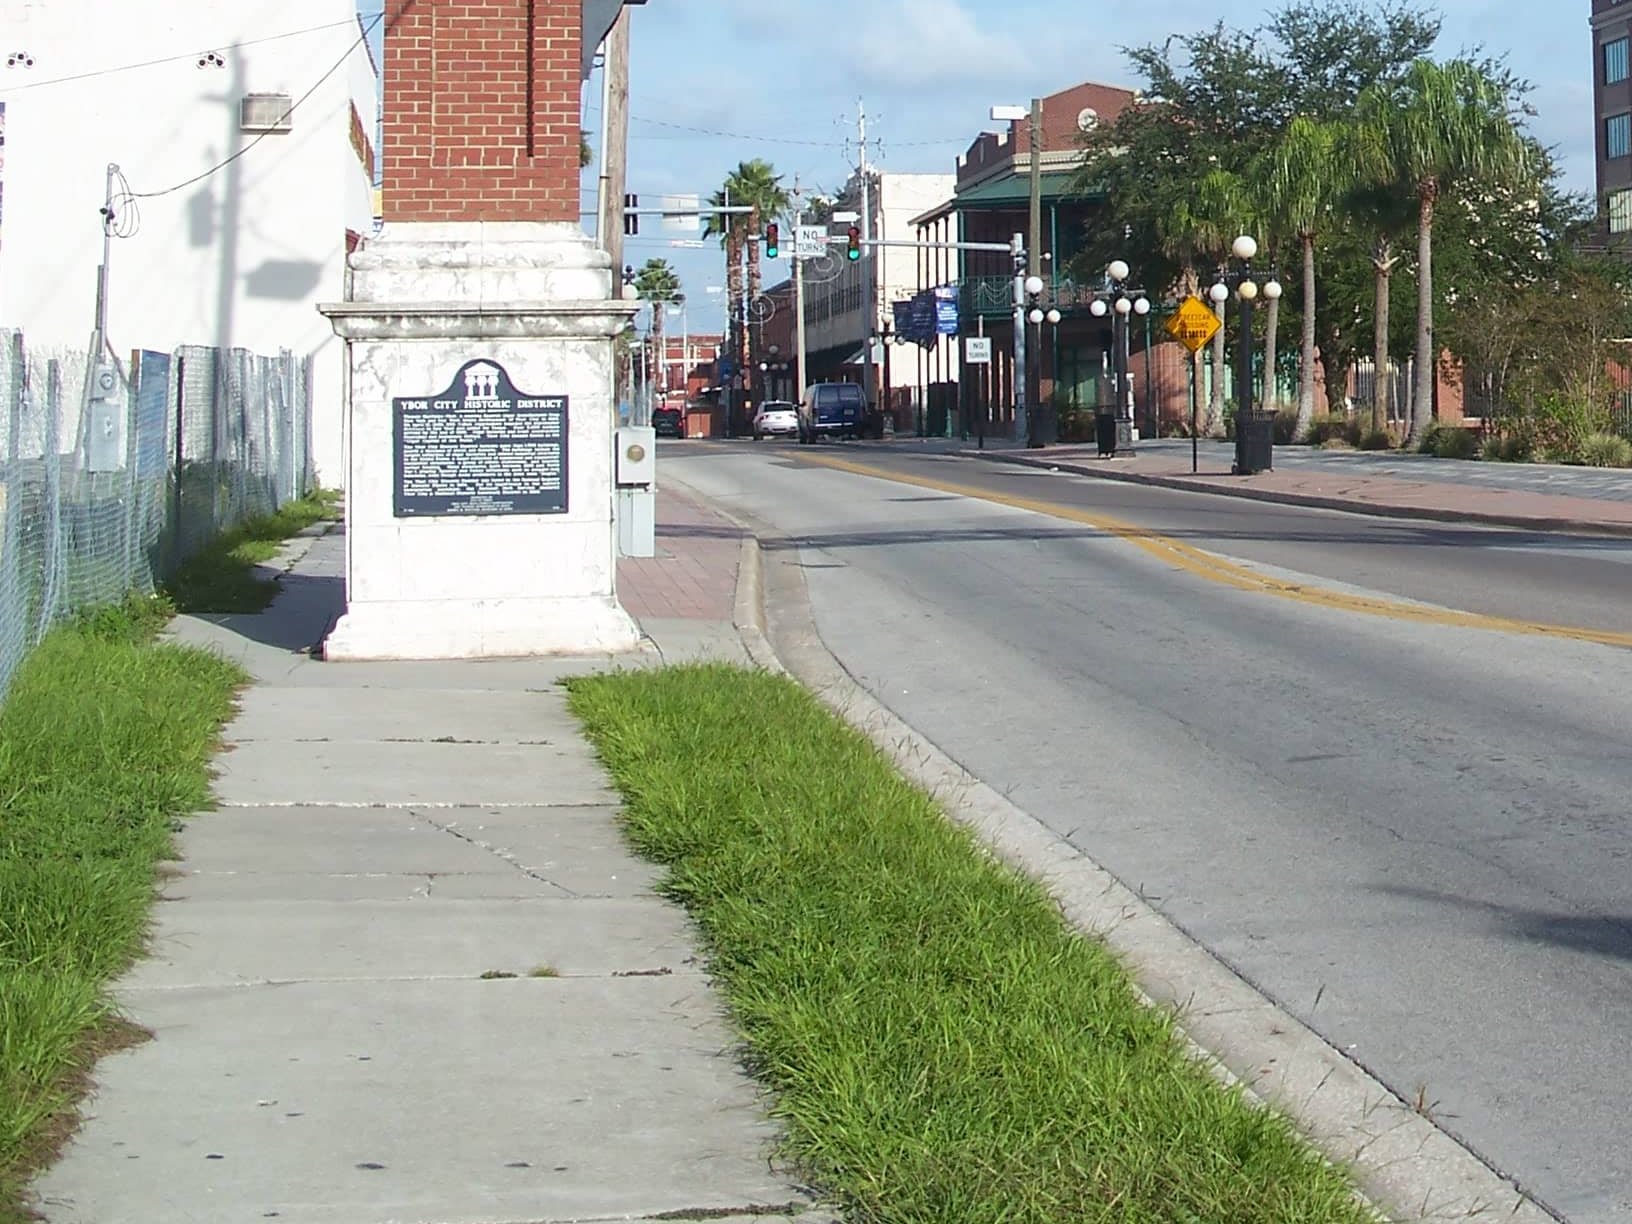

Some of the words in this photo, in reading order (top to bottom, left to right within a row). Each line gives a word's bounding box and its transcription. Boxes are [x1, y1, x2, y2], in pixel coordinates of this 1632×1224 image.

[803, 230, 818, 240] NO
[798, 243, 826, 251] TURNS
[401, 401, 428, 410] YBOR
[434, 400, 458, 409] CITY
[464, 400, 511, 409] HISTORIC
[517, 399, 563, 408] DISTRICT
